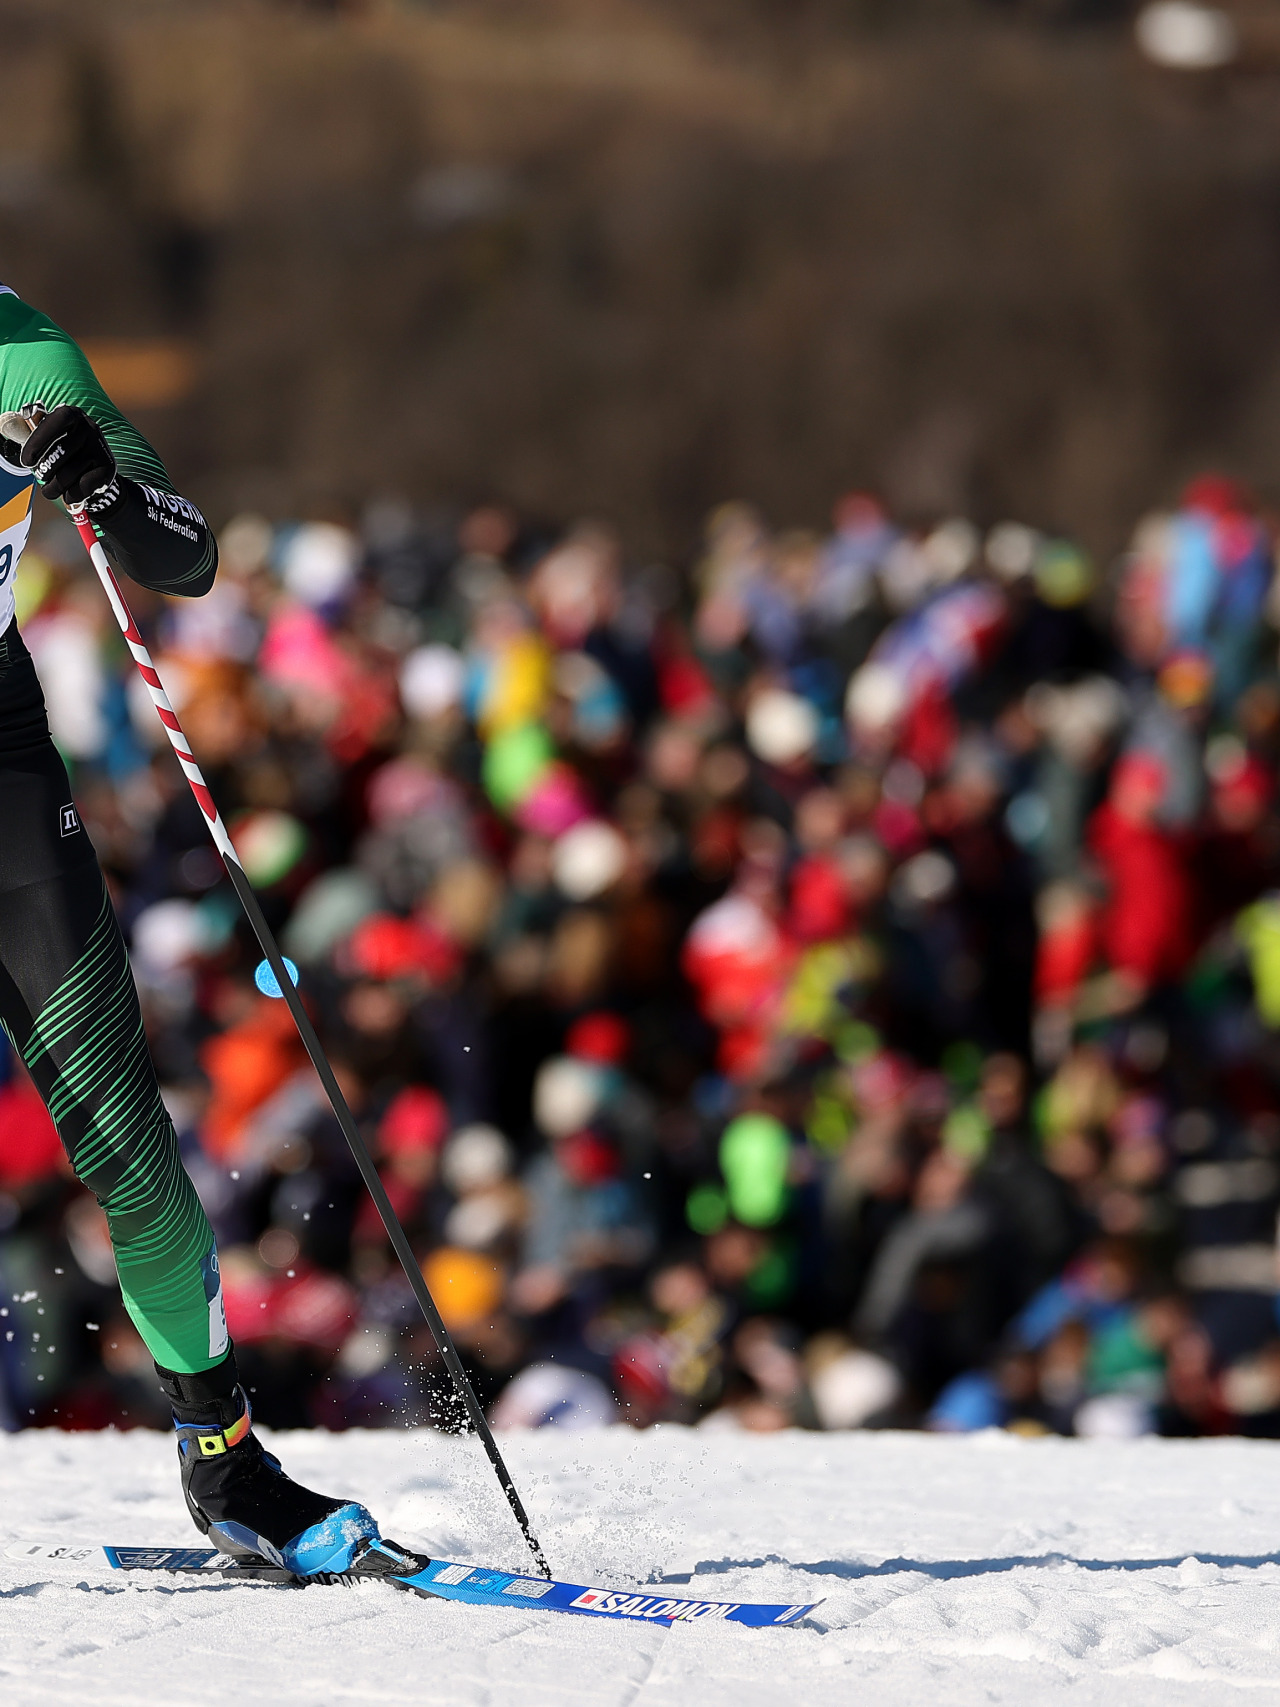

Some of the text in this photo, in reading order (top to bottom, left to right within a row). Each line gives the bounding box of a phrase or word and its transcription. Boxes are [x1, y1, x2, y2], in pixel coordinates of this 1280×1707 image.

[147, 506, 199, 543] Ski Federation
[594, 1593, 740, 1620] SALOMON
